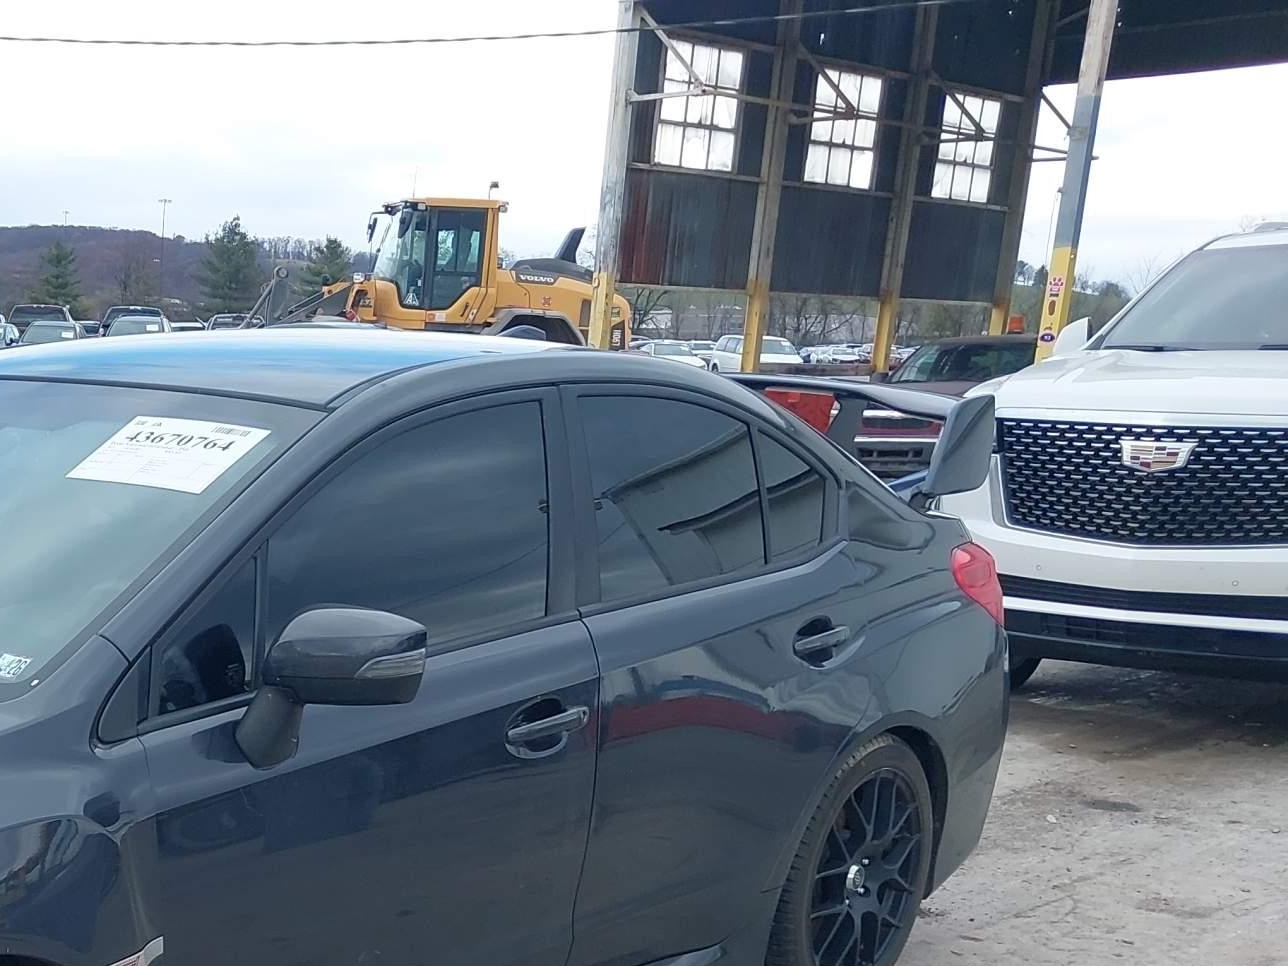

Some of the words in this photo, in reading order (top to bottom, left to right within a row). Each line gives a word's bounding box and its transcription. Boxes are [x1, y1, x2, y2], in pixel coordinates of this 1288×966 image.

[519, 274, 554, 283] VOLVO
[612, 329, 622, 347] L90H
[125, 430, 236, 452] 43670764
